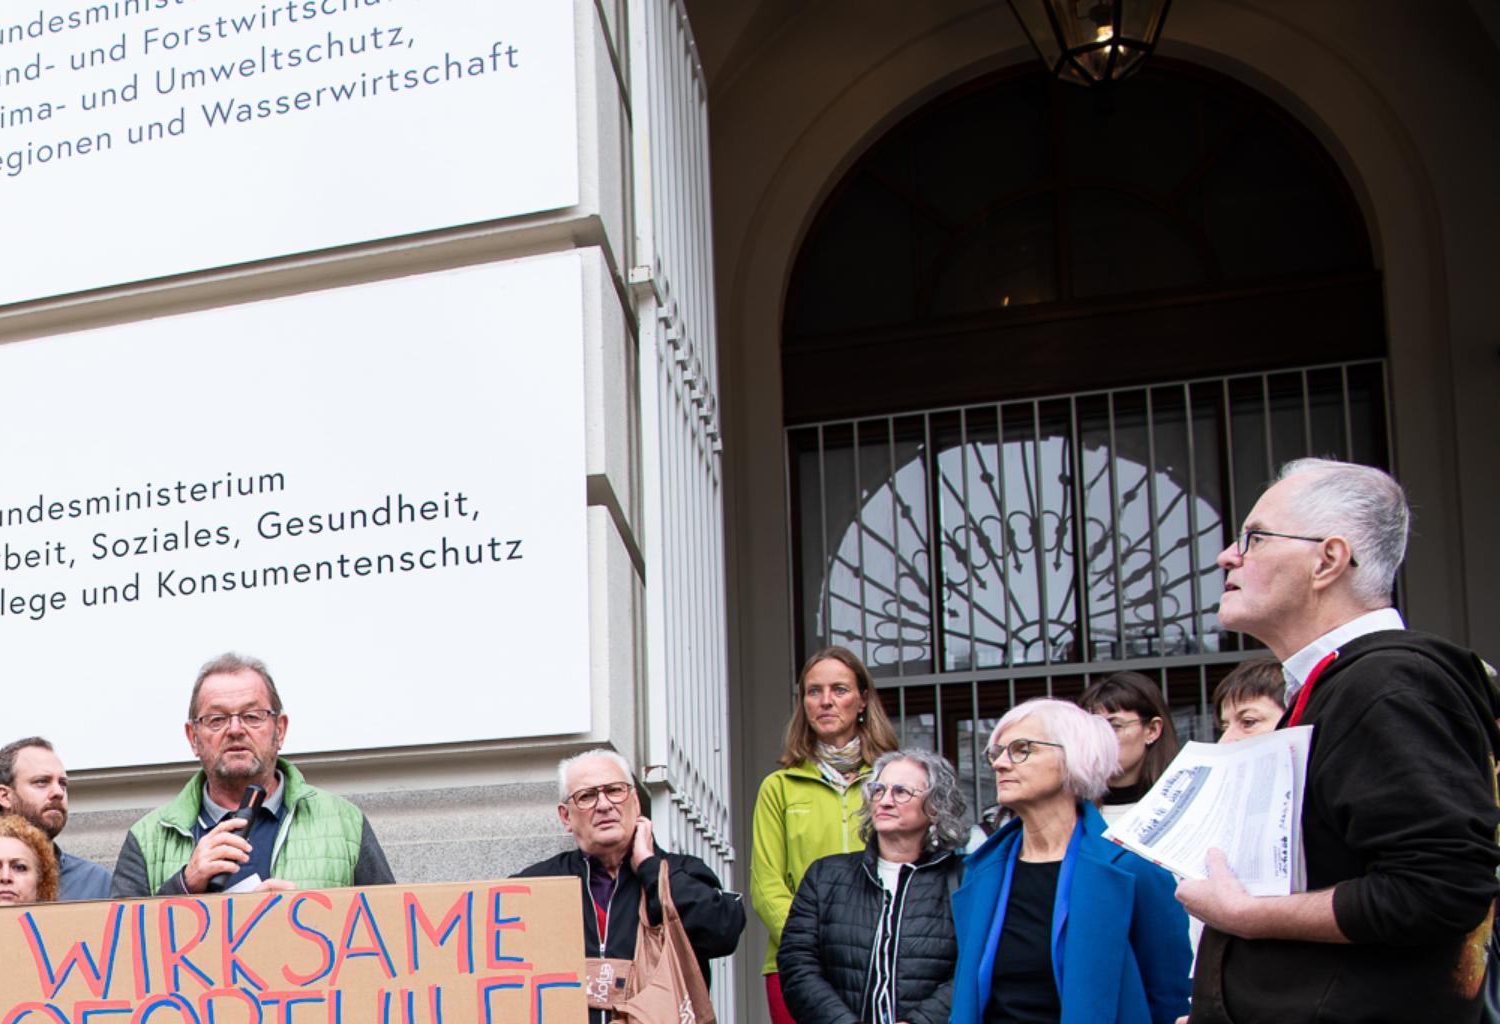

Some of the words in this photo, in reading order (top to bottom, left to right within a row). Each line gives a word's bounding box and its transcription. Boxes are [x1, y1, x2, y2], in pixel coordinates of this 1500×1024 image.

[70, 33, 126, 71] und
[81, 73, 138, 111] und
[155, 26, 414, 94] Umweltschutz,
[128, 107, 185, 144] und
[201, 41, 519, 128] Wasserwirtschaft
[90, 517, 242, 563] Soziales,
[257, 490, 481, 541] Gesundheit,
[81, 575, 141, 609] und
[157, 535, 525, 600] Konsumentenschutz
[17, 885, 533, 1002] WIRKSAME
